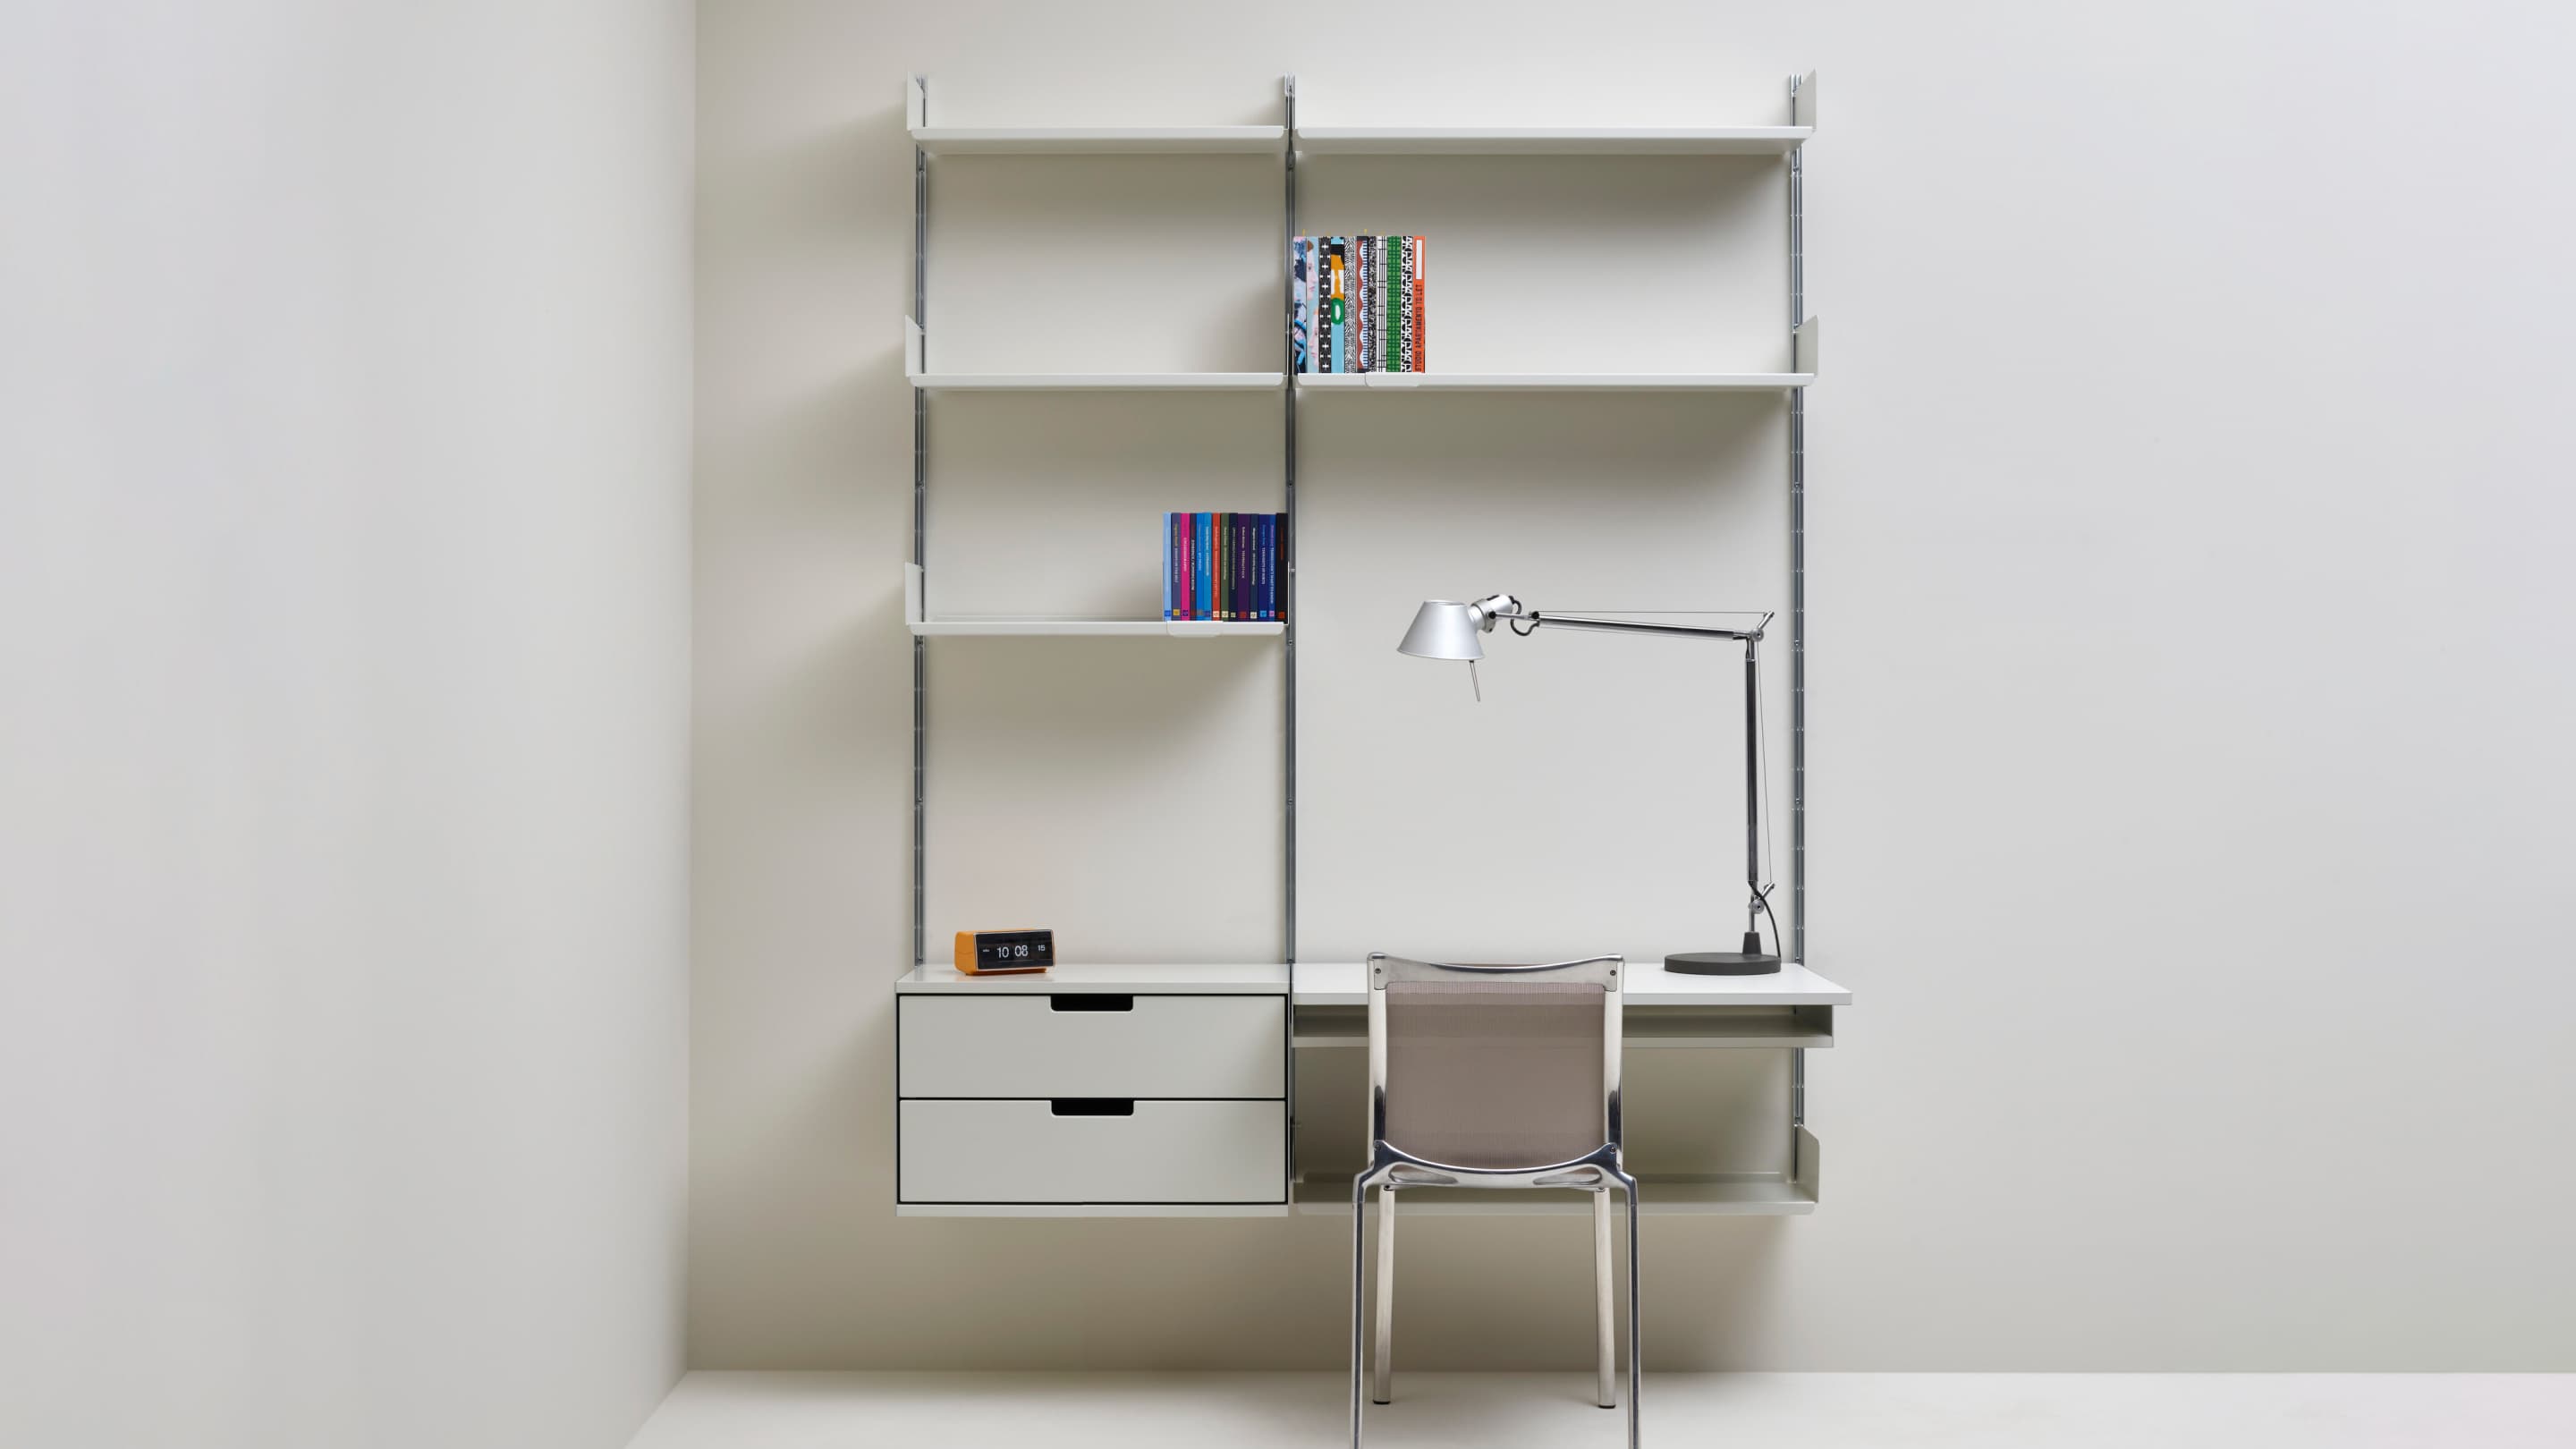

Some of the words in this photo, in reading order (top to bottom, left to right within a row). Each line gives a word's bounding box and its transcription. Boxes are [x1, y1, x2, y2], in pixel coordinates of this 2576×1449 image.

[1416, 297, 1422, 305] TO
[997, 946, 1009, 959] 10
[1014, 945, 1029, 957] 08
